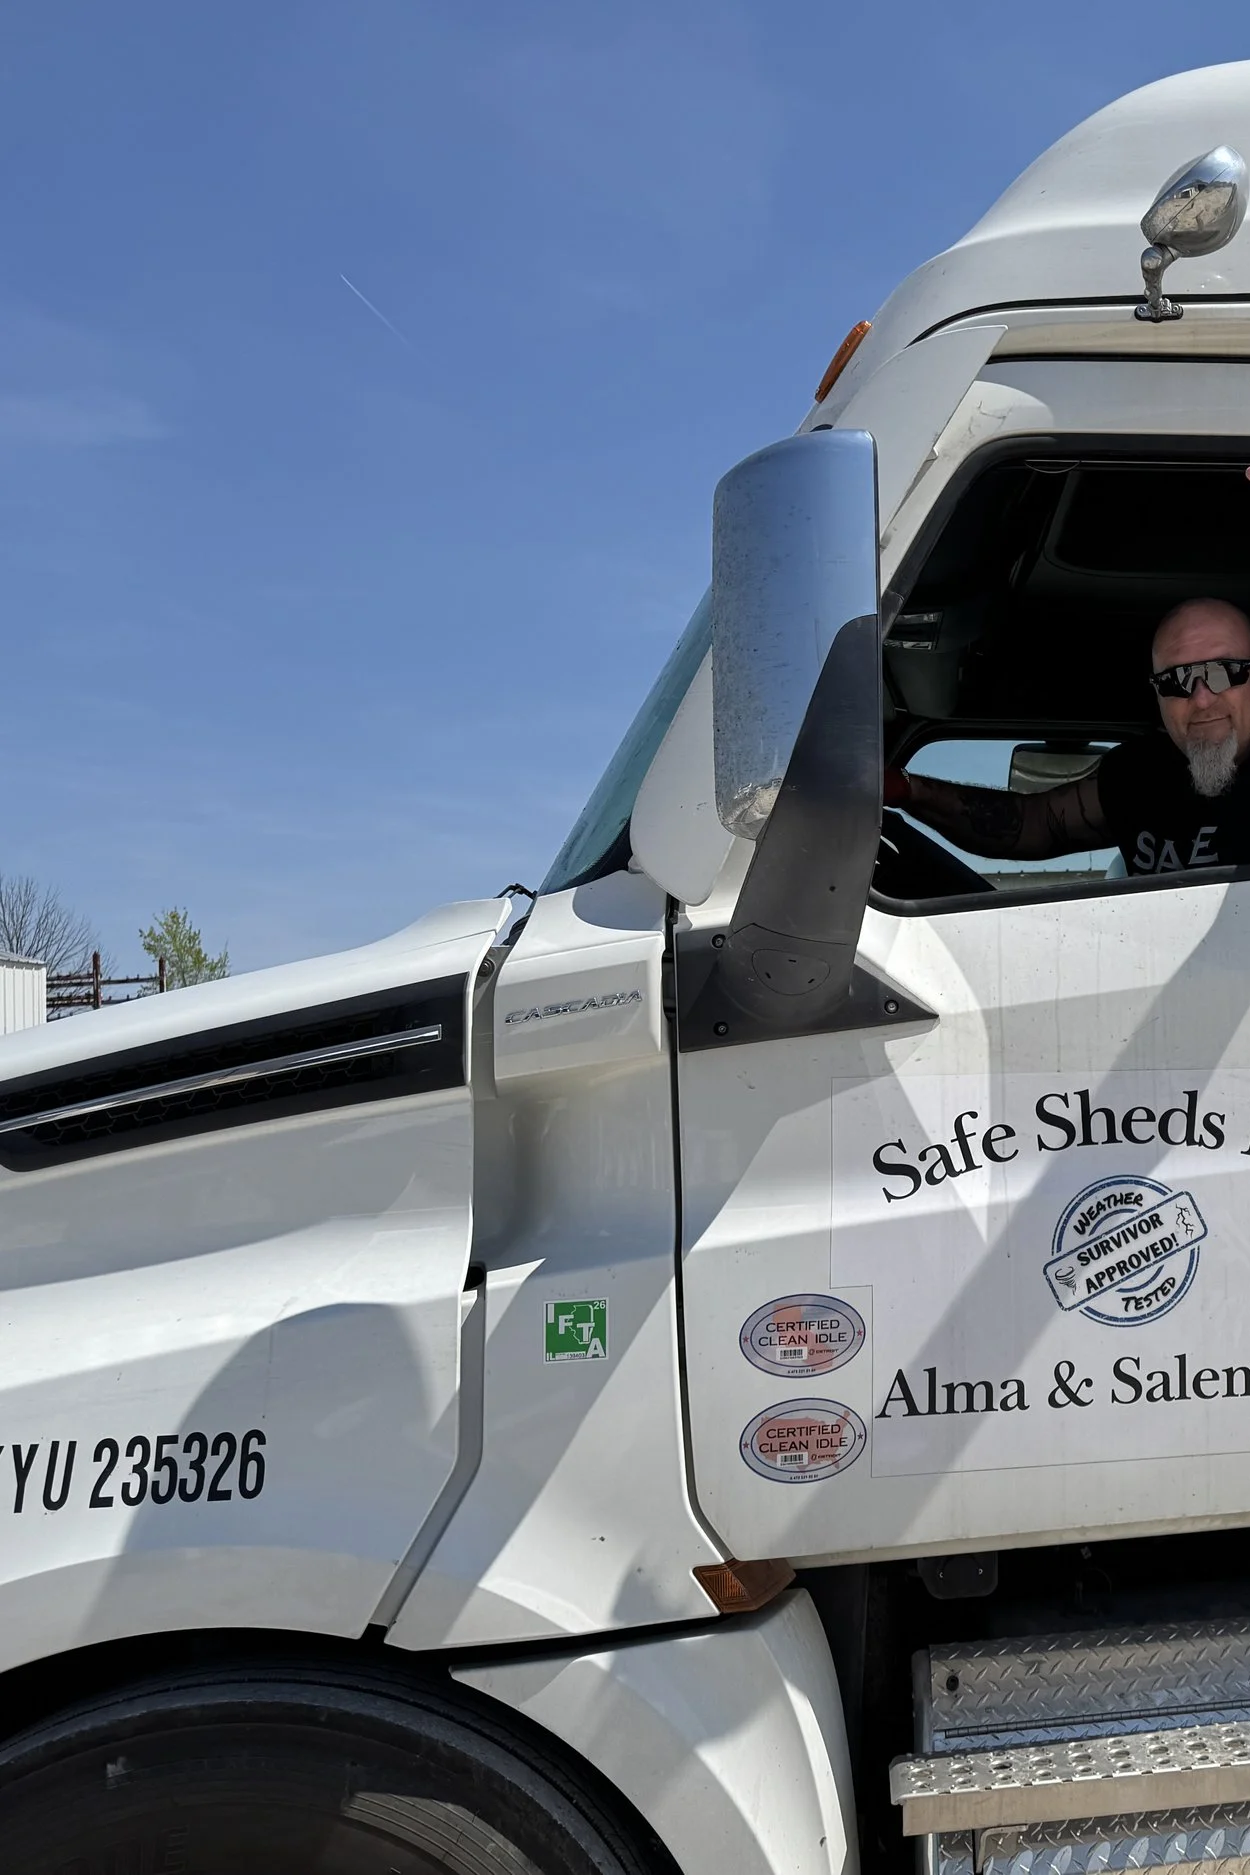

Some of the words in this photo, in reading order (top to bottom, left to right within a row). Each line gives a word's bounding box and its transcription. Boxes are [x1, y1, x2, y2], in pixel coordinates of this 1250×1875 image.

[505, 989, 643, 1025] CASCADIA
[872, 1110, 1019, 1204] Safe
[1034, 1089, 1226, 1152] Sheds
[1073, 1192, 1144, 1236] WEATHER
[1076, 1212, 1164, 1267] SURVIVOR
[1085, 1233, 1179, 1294] APPROVED!
[593, 1301, 606, 1310] 26
[1121, 1276, 1176, 1312] TESTED
[758, 1334, 808, 1347] CLEAN
[815, 1332, 847, 1344] IDLE
[765, 1319, 840, 1333] CERTIFIED
[875, 1367, 1029, 1419] Alma
[1047, 1360, 1094, 1409] &
[759, 1440, 809, 1453] CLEAN
[816, 1437, 848, 1449] IDLE
[766, 1424, 841, 1439] CERTIFIED
[0, 1440, 77, 1513] YU
[89, 1429, 267, 1509] 235326
